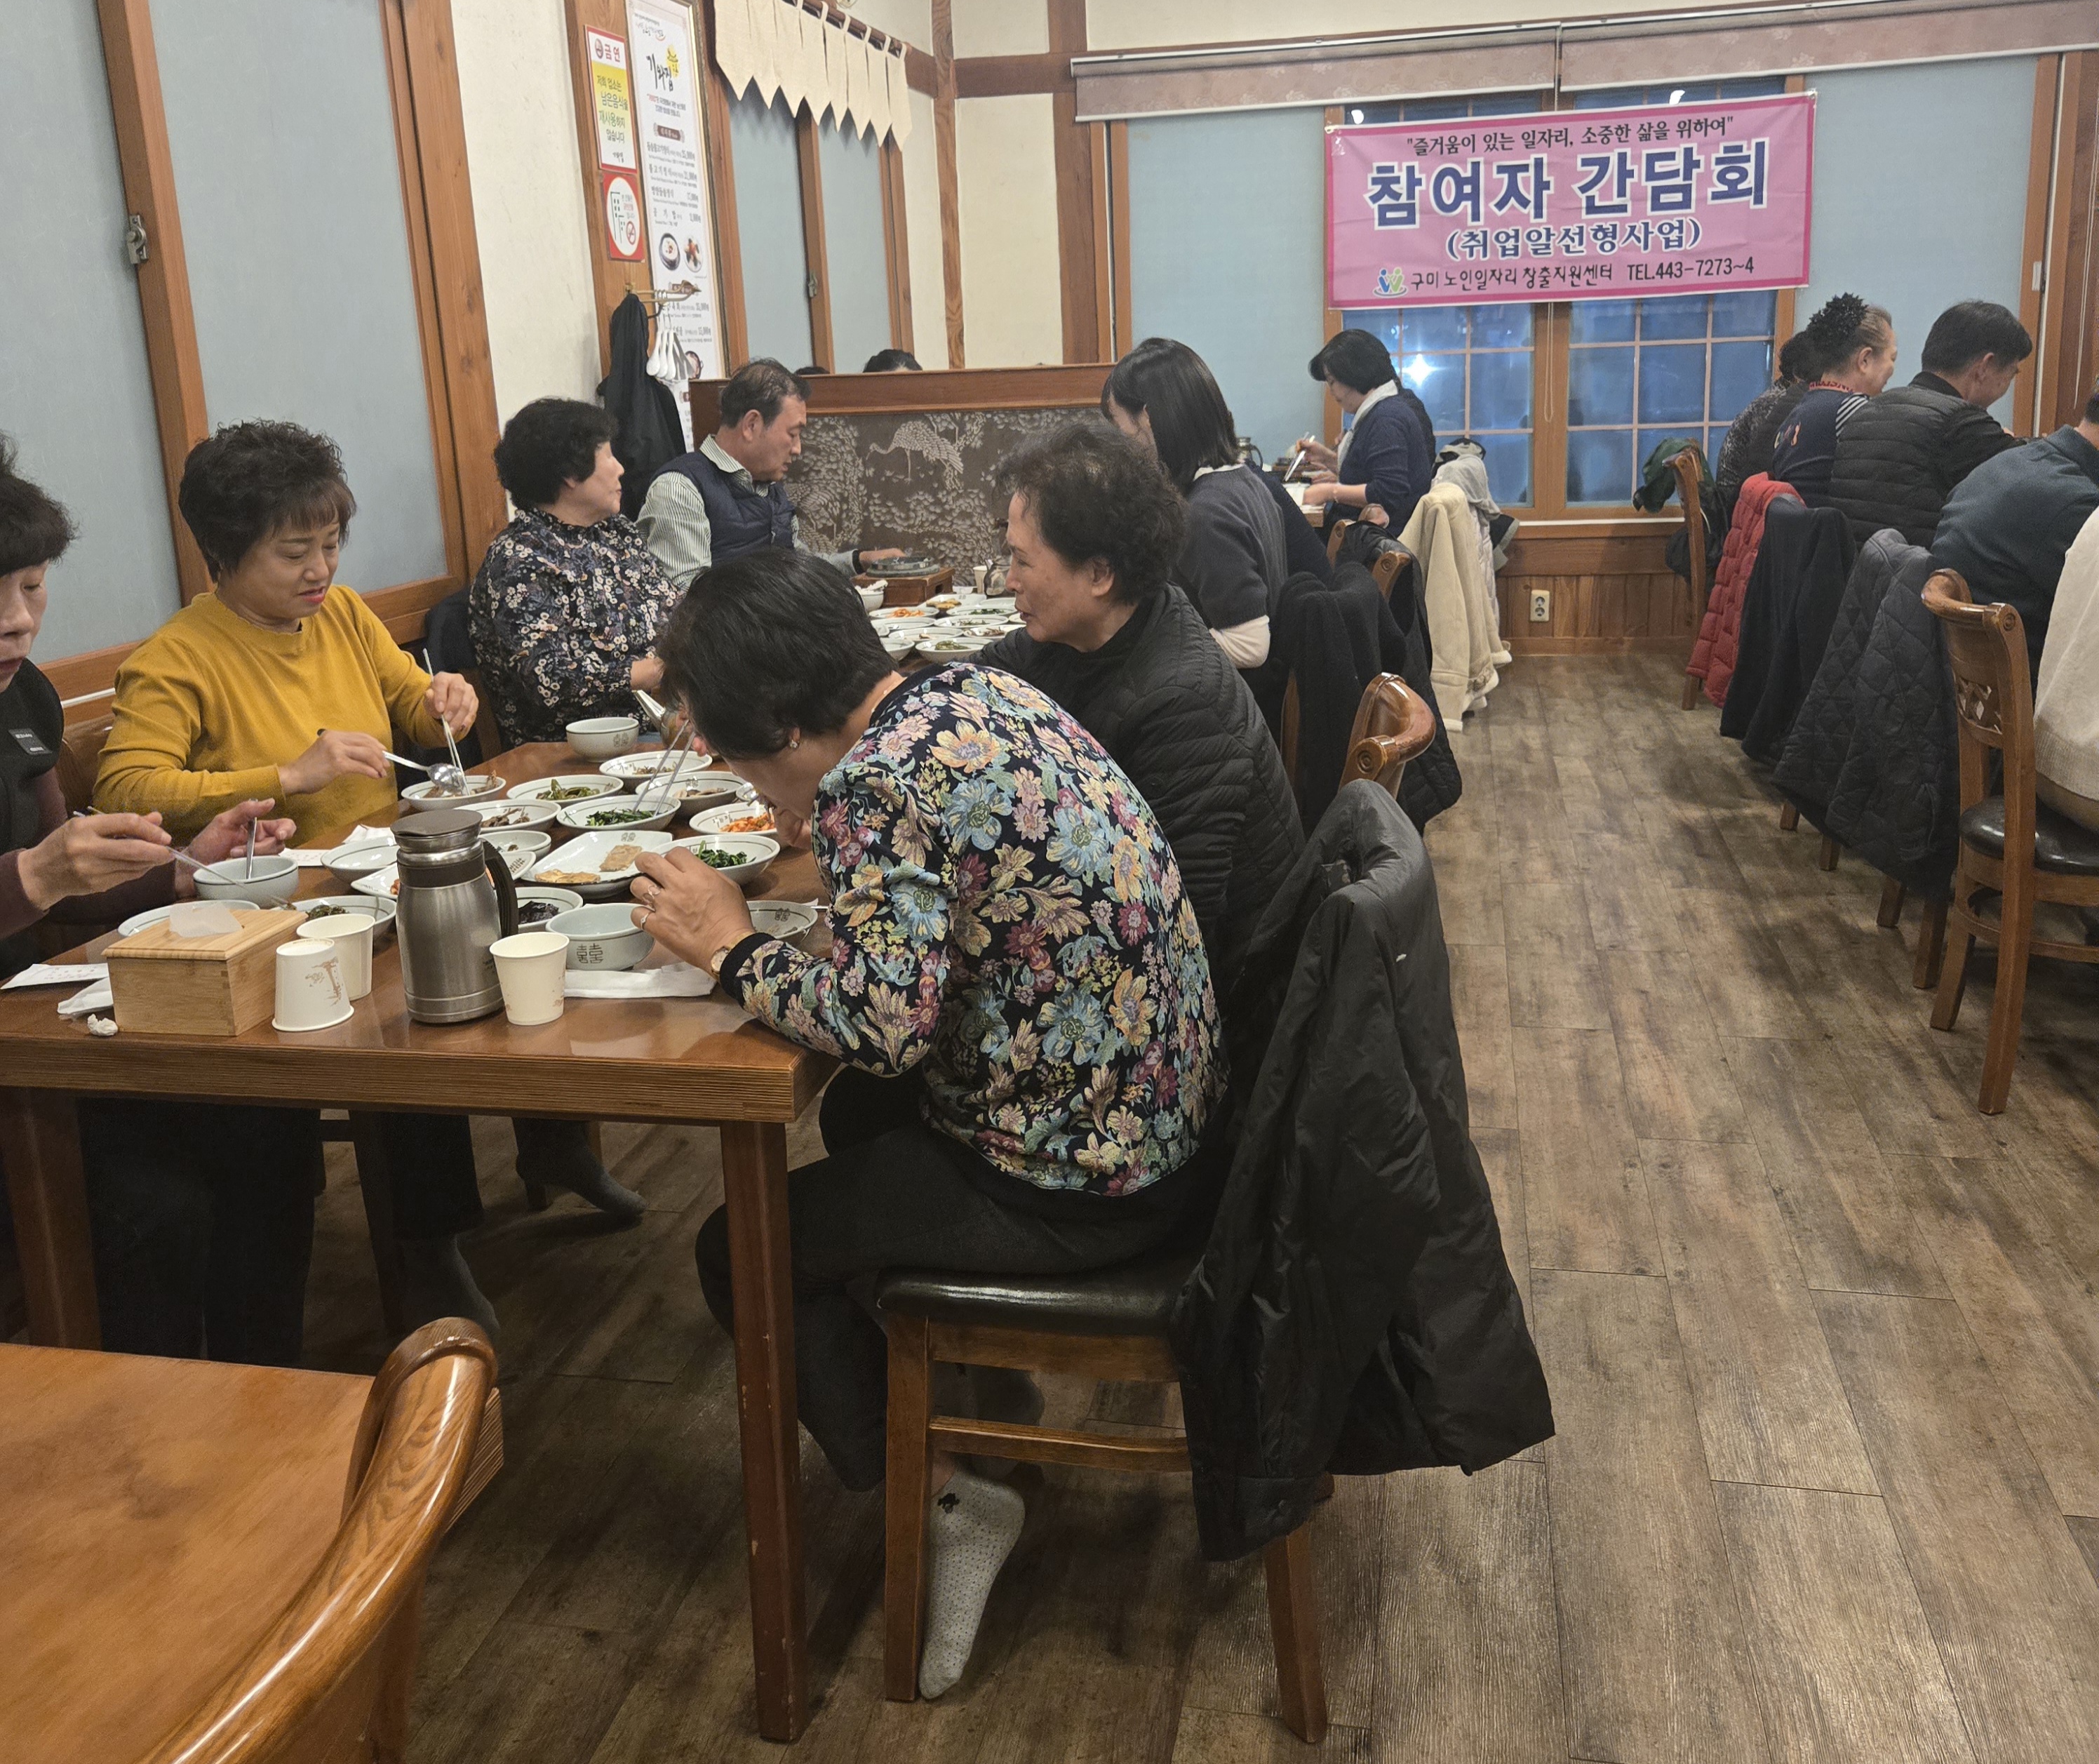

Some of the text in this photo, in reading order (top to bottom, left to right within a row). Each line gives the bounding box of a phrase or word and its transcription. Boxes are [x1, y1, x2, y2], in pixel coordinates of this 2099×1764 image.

[1483, 133, 1515, 152] 있는
[1521, 128, 1573, 148] 일자리,
[1581, 124, 1631, 145] 소중한
[1637, 121, 1670, 141] 삶을
[1366, 139, 1767, 228] 참여자 간담회
[1447, 218, 1703, 260] (취업알선형사업)
[1411, 273, 1439, 290] 구미
[1444, 268, 1517, 290] 노인일자리
[1524, 264, 1612, 288] 창출지원센터
